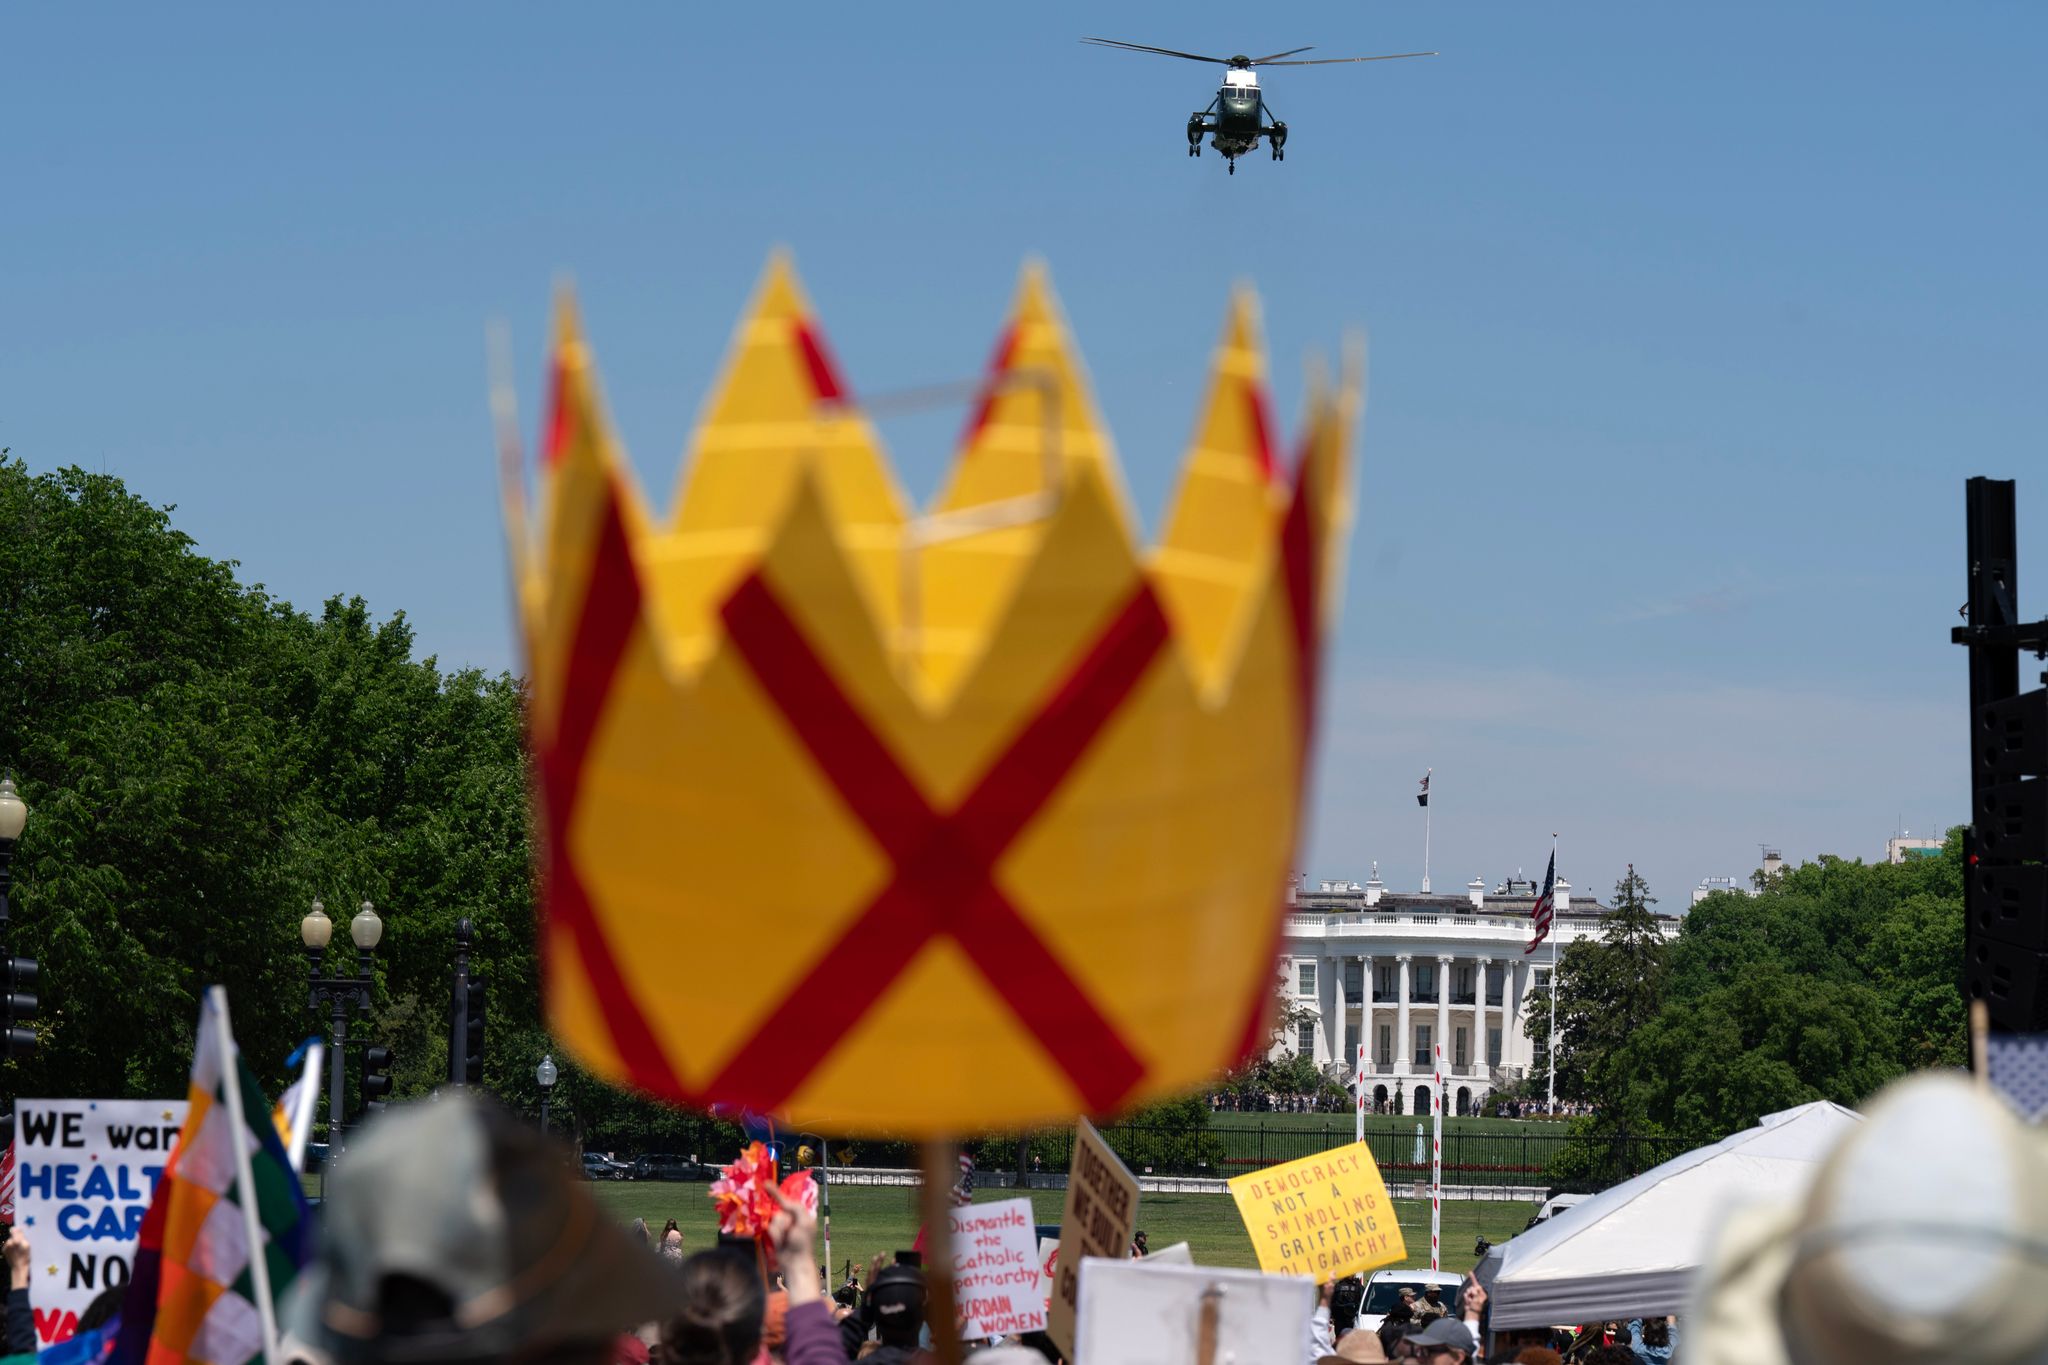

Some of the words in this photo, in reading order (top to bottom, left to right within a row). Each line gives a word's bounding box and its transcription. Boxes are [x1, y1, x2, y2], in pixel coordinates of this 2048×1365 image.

[22, 1110, 85, 1148] WE
[106, 1125, 180, 1150] wan
[20, 1162, 165, 1200] HEALT
[1251, 1154, 1360, 1200] DEMOCRACY
[1267, 1194, 1377, 1240] SWINDLING
[1272, 1191, 1307, 1216] NOT
[1331, 1183, 1341, 1198] A
[57, 1204, 147, 1241] CAR
[974, 1234, 1001, 1247] the
[1280, 1215, 1377, 1260] GRIFTING
[953, 1247, 1025, 1273] Catholic
[953, 1266, 1039, 1295] patriarchy
[980, 1311, 1043, 1334] WOMEN
